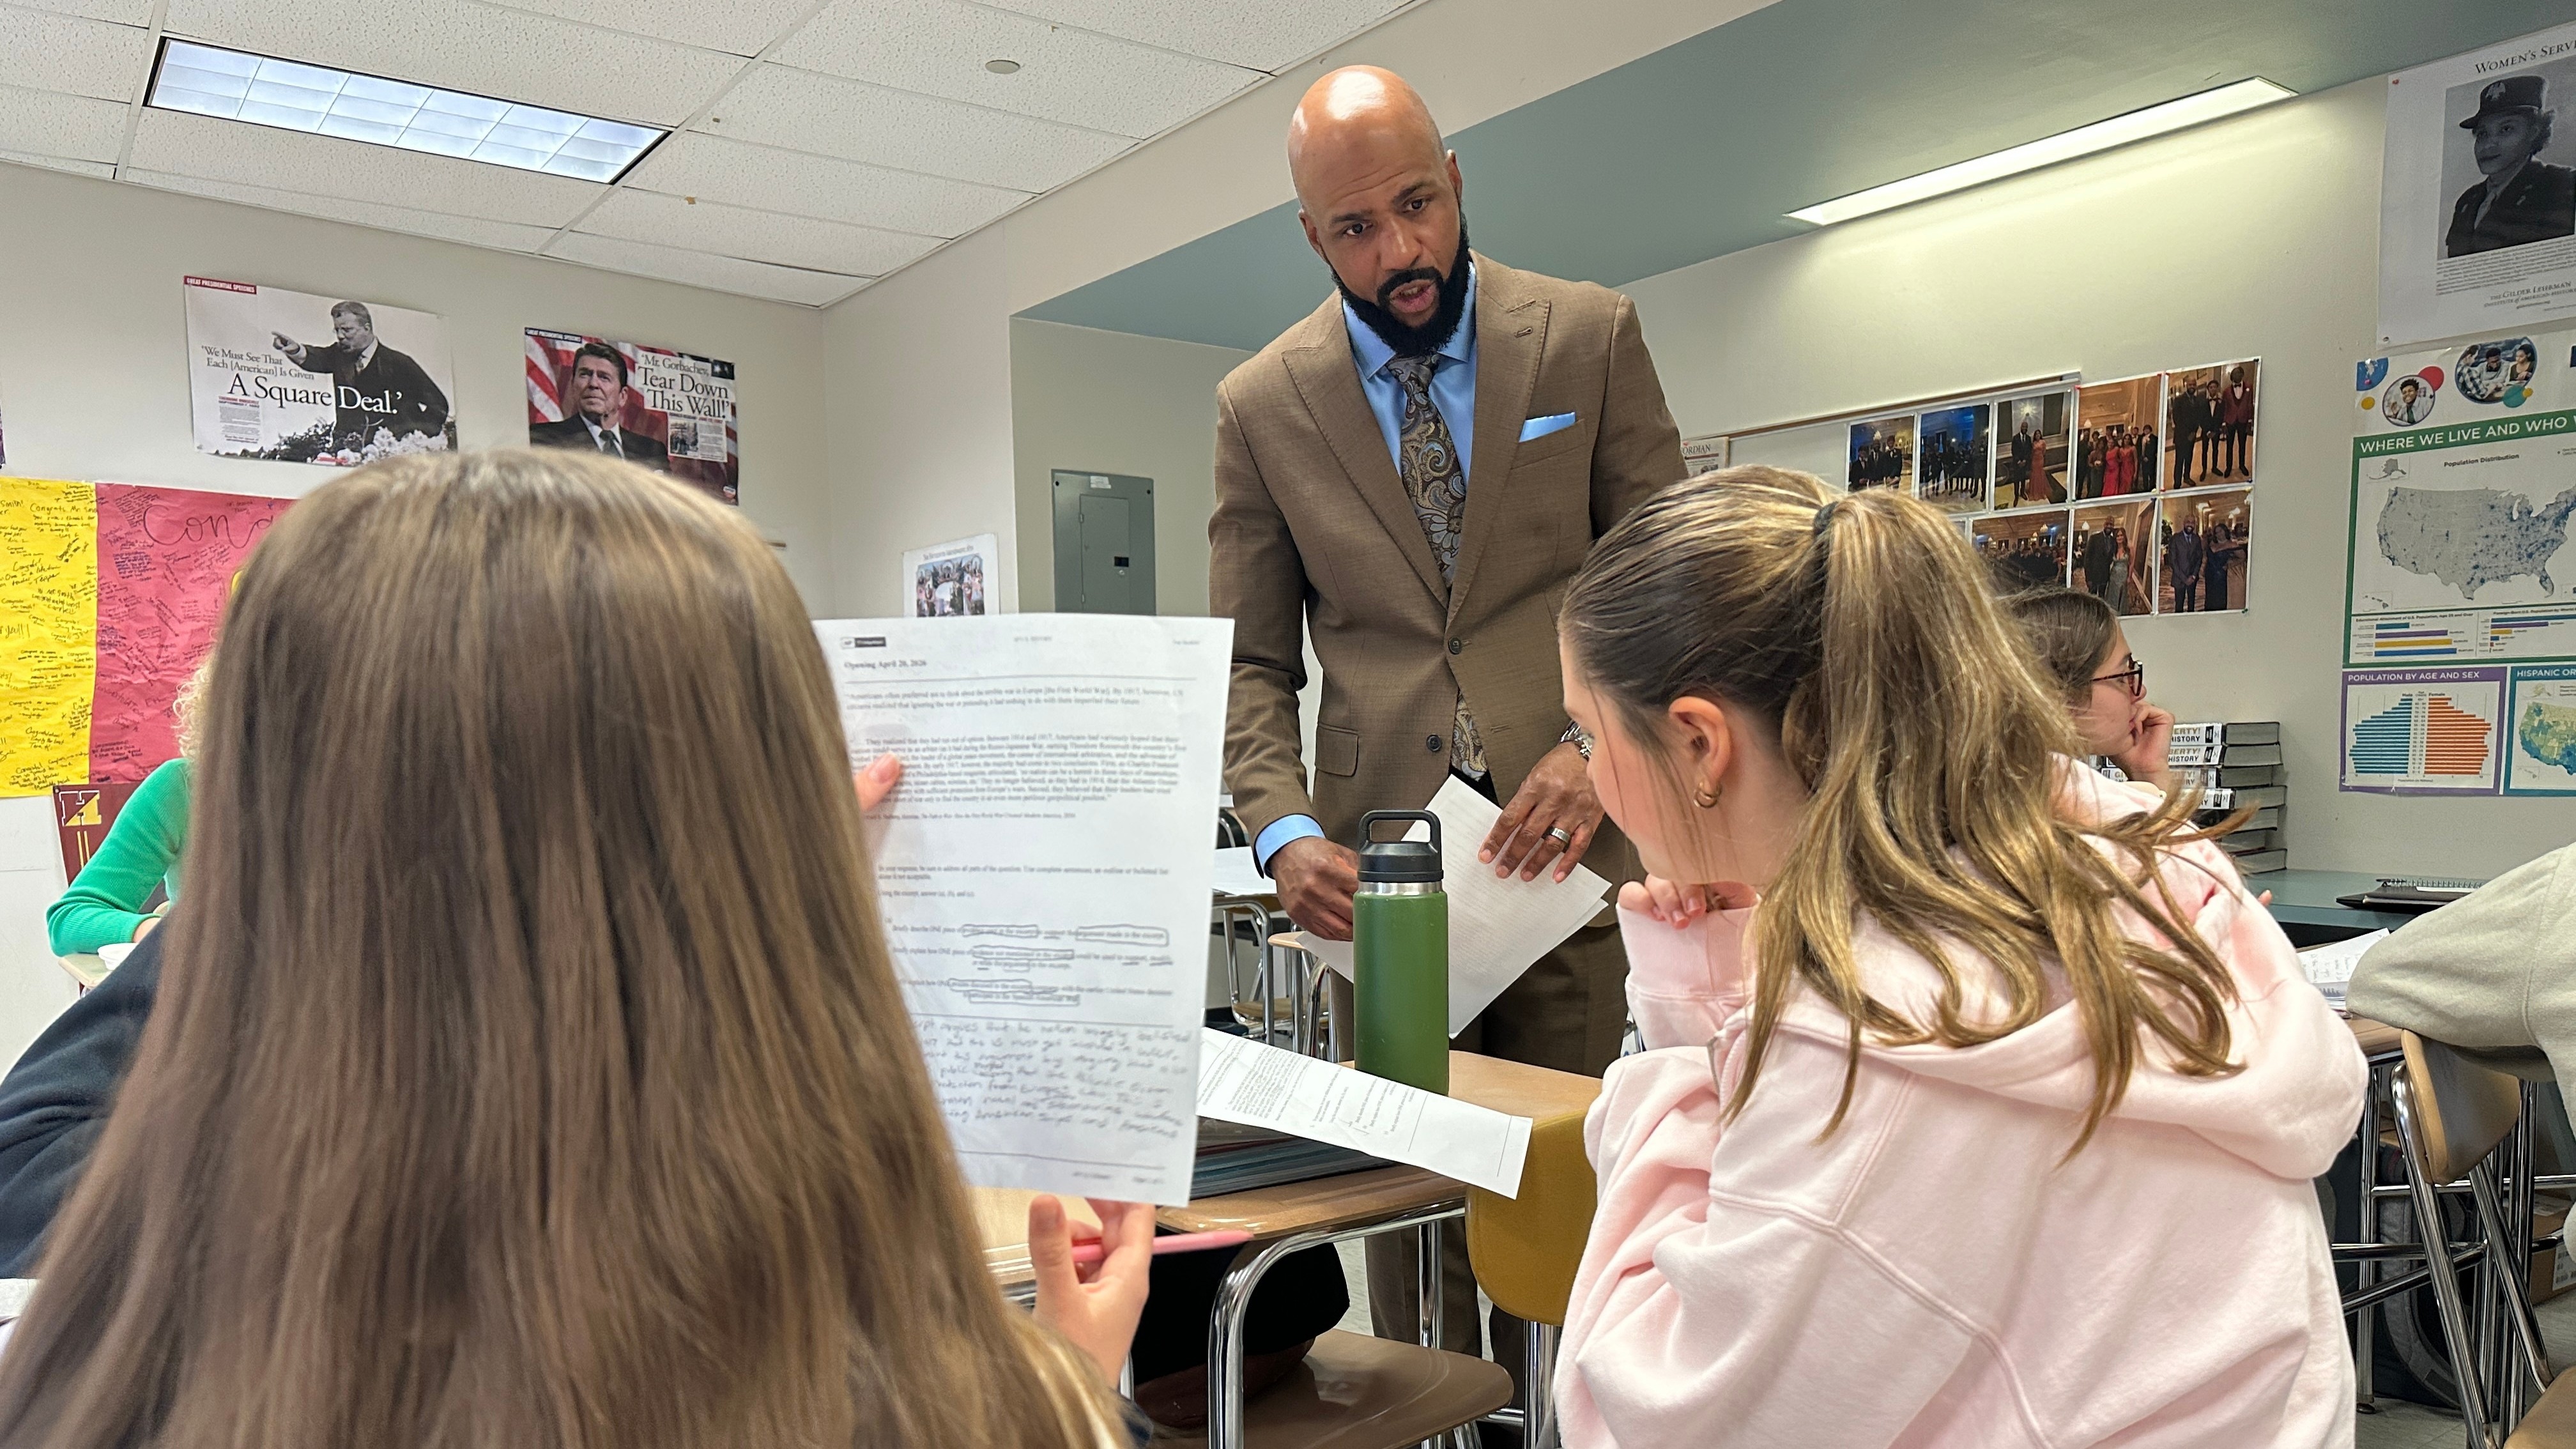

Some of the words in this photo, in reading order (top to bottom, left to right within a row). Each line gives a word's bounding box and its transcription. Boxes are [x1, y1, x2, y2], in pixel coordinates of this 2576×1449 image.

[2474, 49, 2536, 74] WOMEN'S
[2503, 288, 2531, 298] GILDER
[221, 349, 244, 362] Must
[245, 351, 261, 363] See
[261, 353, 283, 365] That
[662, 357, 710, 377] Gorbachev,
[206, 358, 228, 369] Each
[230, 359, 278, 377] [American]
[279, 367, 287, 376] Is
[289, 369, 314, 380] Given
[227, 372, 250, 397] A
[254, 375, 332, 409] Square
[638, 366, 676, 390] Tear
[679, 373, 728, 399] Down
[646, 388, 684, 412] This
[2360, 436, 2414, 453] WHERE
[2419, 432, 2444, 445] WE
[2448, 427, 2481, 443] LIVE
[2485, 422, 2520, 438] AND
[2526, 417, 2567, 433] WHO
[1682, 444, 1711, 455] ORDIAN
[2444, 457, 2479, 468] Population
[2480, 454, 2519, 463] Distribution
[2348, 673, 2402, 682] POPULATION
[2405, 672, 2417, 680] BY
[2517, 669, 2560, 677] HISPANIC
